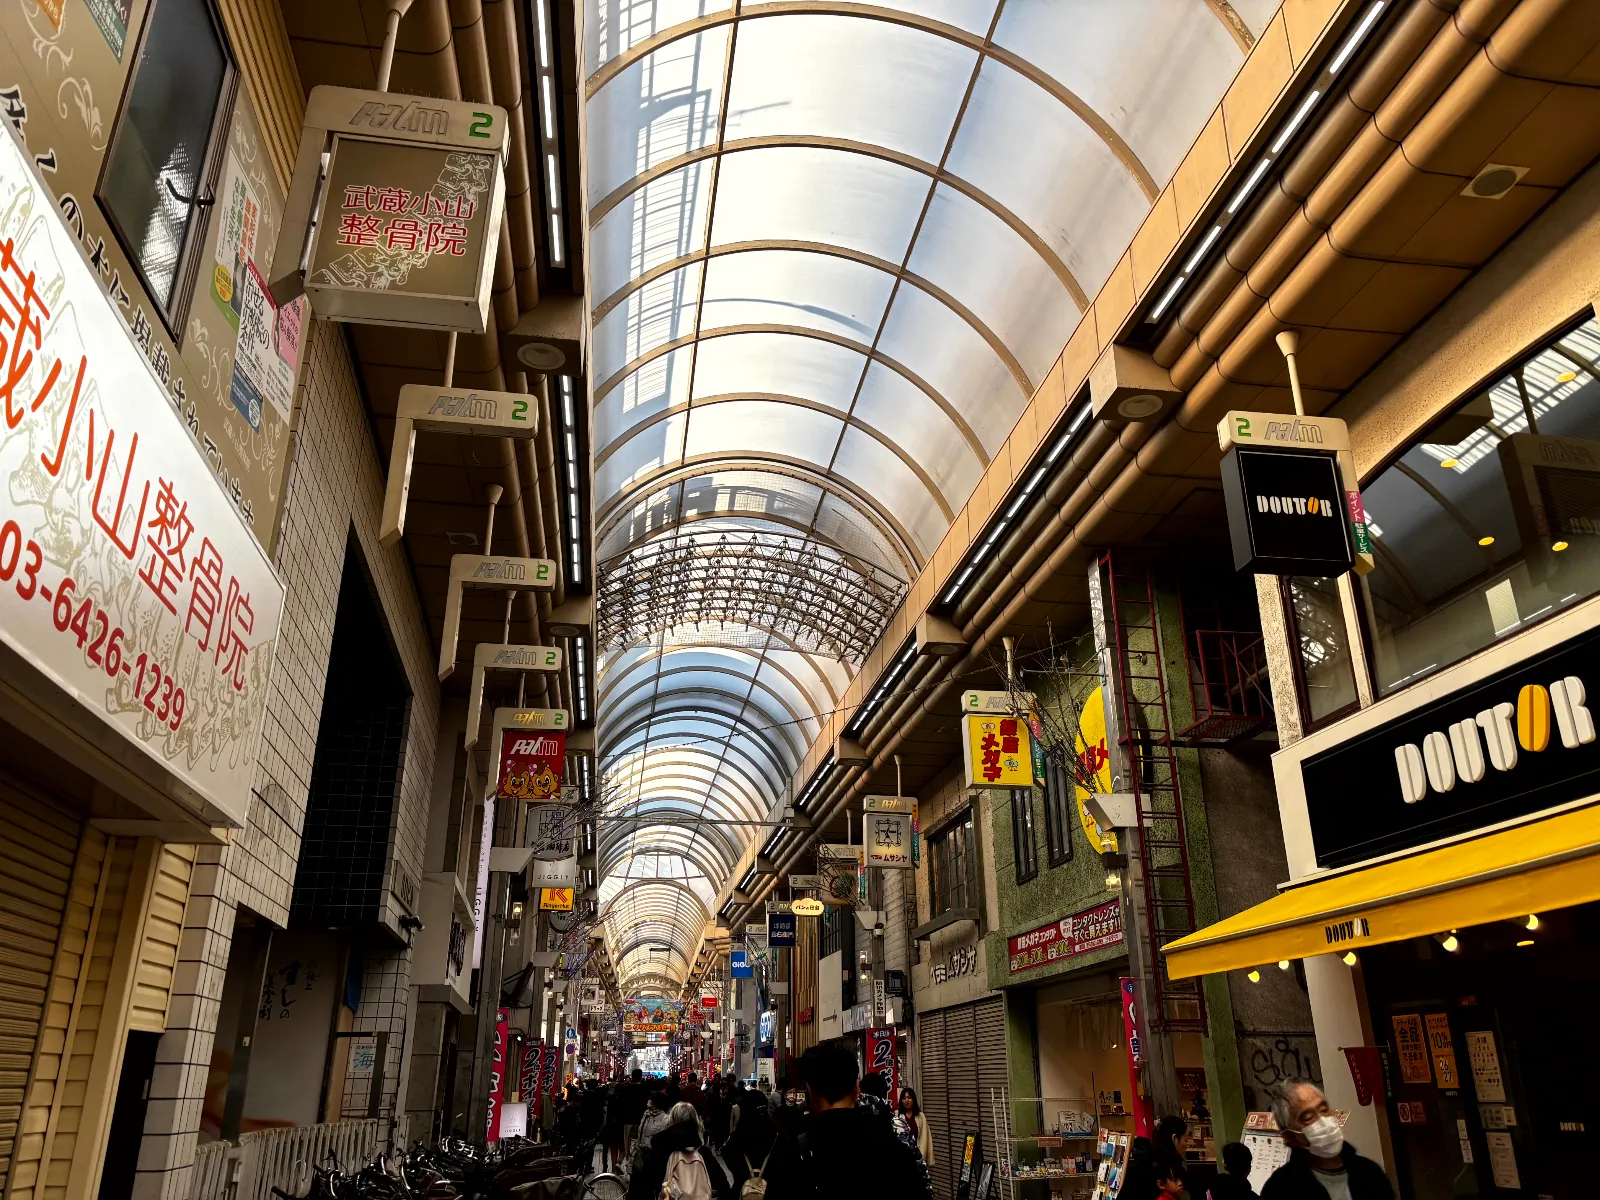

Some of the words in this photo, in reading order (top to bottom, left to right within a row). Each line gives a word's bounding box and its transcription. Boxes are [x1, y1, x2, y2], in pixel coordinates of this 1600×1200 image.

[469, 112, 493, 138] 2
[342, 184, 475, 220] 武蔵小山
[337, 213, 467, 256] 整骨院
[512, 400, 528, 420] 2
[1236, 417, 1251, 437] 2
[1256, 495, 1332, 517] DOUTOR
[1348, 492, 1359, 521] ポイント
[536, 563, 548, 581] 2
[0, 520, 185, 731] 03-6426-1239
[545, 651, 556, 665] 2
[969, 694, 979, 707] 2
[554, 713, 564, 725] 2
[1000, 719, 1019, 754] 銀座
[1395, 676, 1596, 804] DOUTOR
[981, 733, 1003, 782] メガネ
[868, 799, 875, 807] 2
[883, 854, 907, 862] ムサシヤ
[1325, 918, 1370, 944] DOUTOR
[1399, 1027, 1420, 1043] 全品
